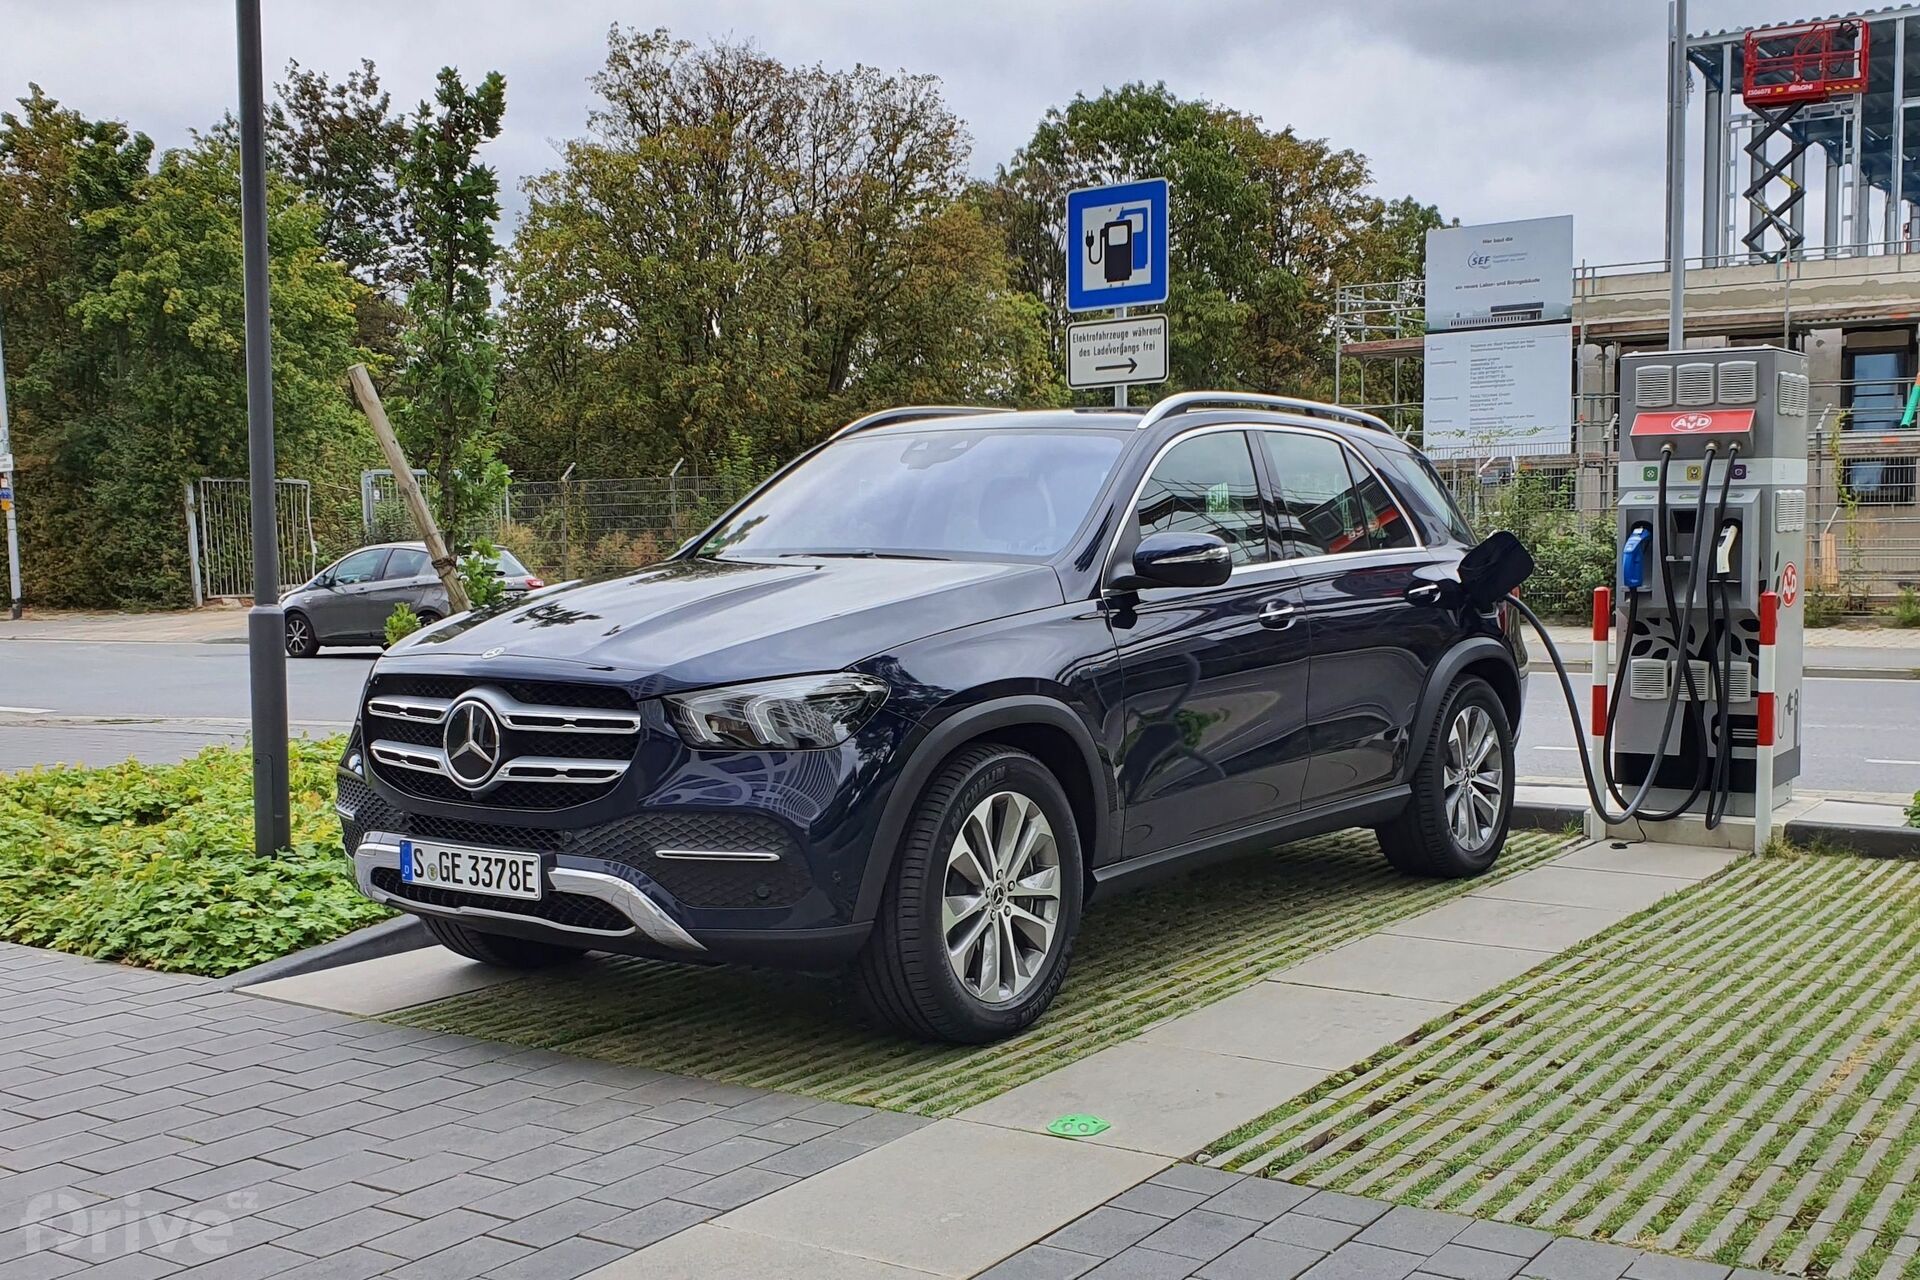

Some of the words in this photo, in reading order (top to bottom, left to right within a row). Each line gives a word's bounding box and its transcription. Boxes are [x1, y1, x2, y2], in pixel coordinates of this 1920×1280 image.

[1471, 255, 1491, 266] SEF
[1072, 329, 1129, 344] Elektrofahrzeuge
[1132, 324, 1162, 338] während
[1078, 347, 1091, 358] des
[1093, 342, 1140, 357] Ladevorgangs
[1142, 340, 1156, 351] frei
[950, 765, 1007, 834] MICHELIN
[403, 864, 410, 875] D
[413, 847, 425, 878] S
[438, 850, 464, 885] GE
[468, 854, 536, 893] 3378E
